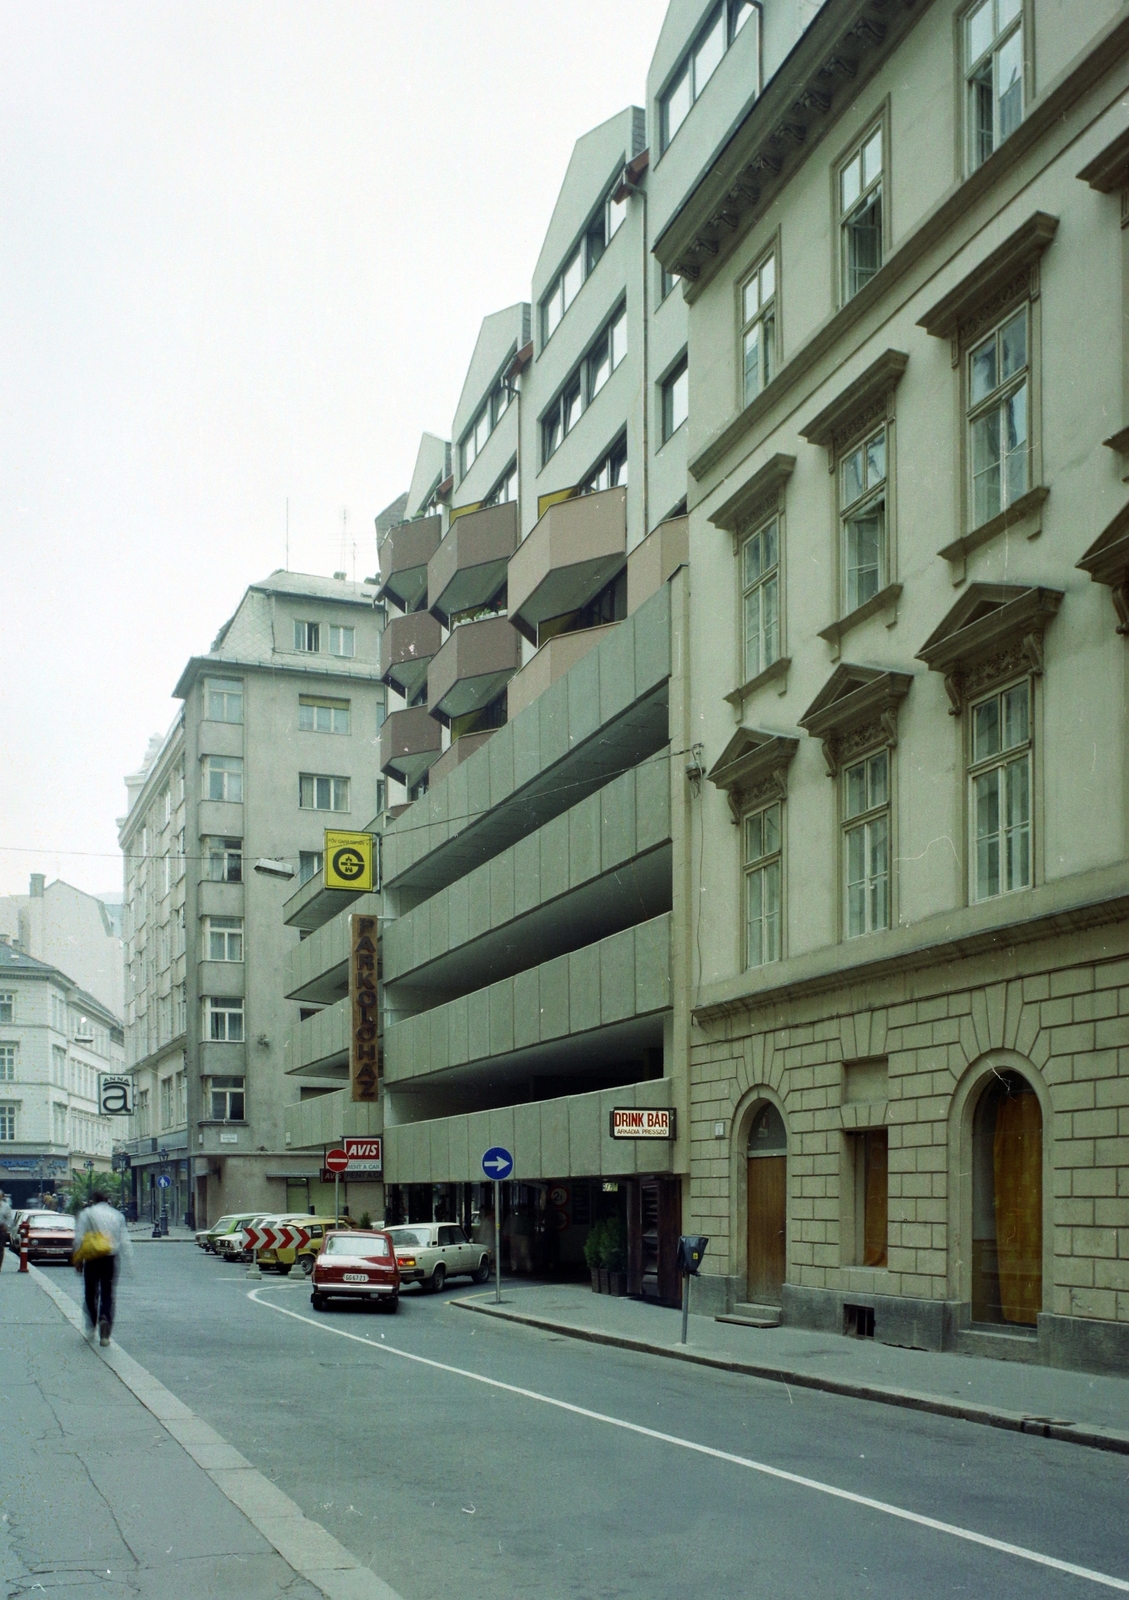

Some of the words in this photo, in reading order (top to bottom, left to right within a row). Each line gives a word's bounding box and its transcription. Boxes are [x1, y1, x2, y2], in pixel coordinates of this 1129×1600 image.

[615, 1112, 644, 1127] DRINK
[647, 1111, 668, 1127] BÁR
[348, 1144, 377, 1156] AVIS
